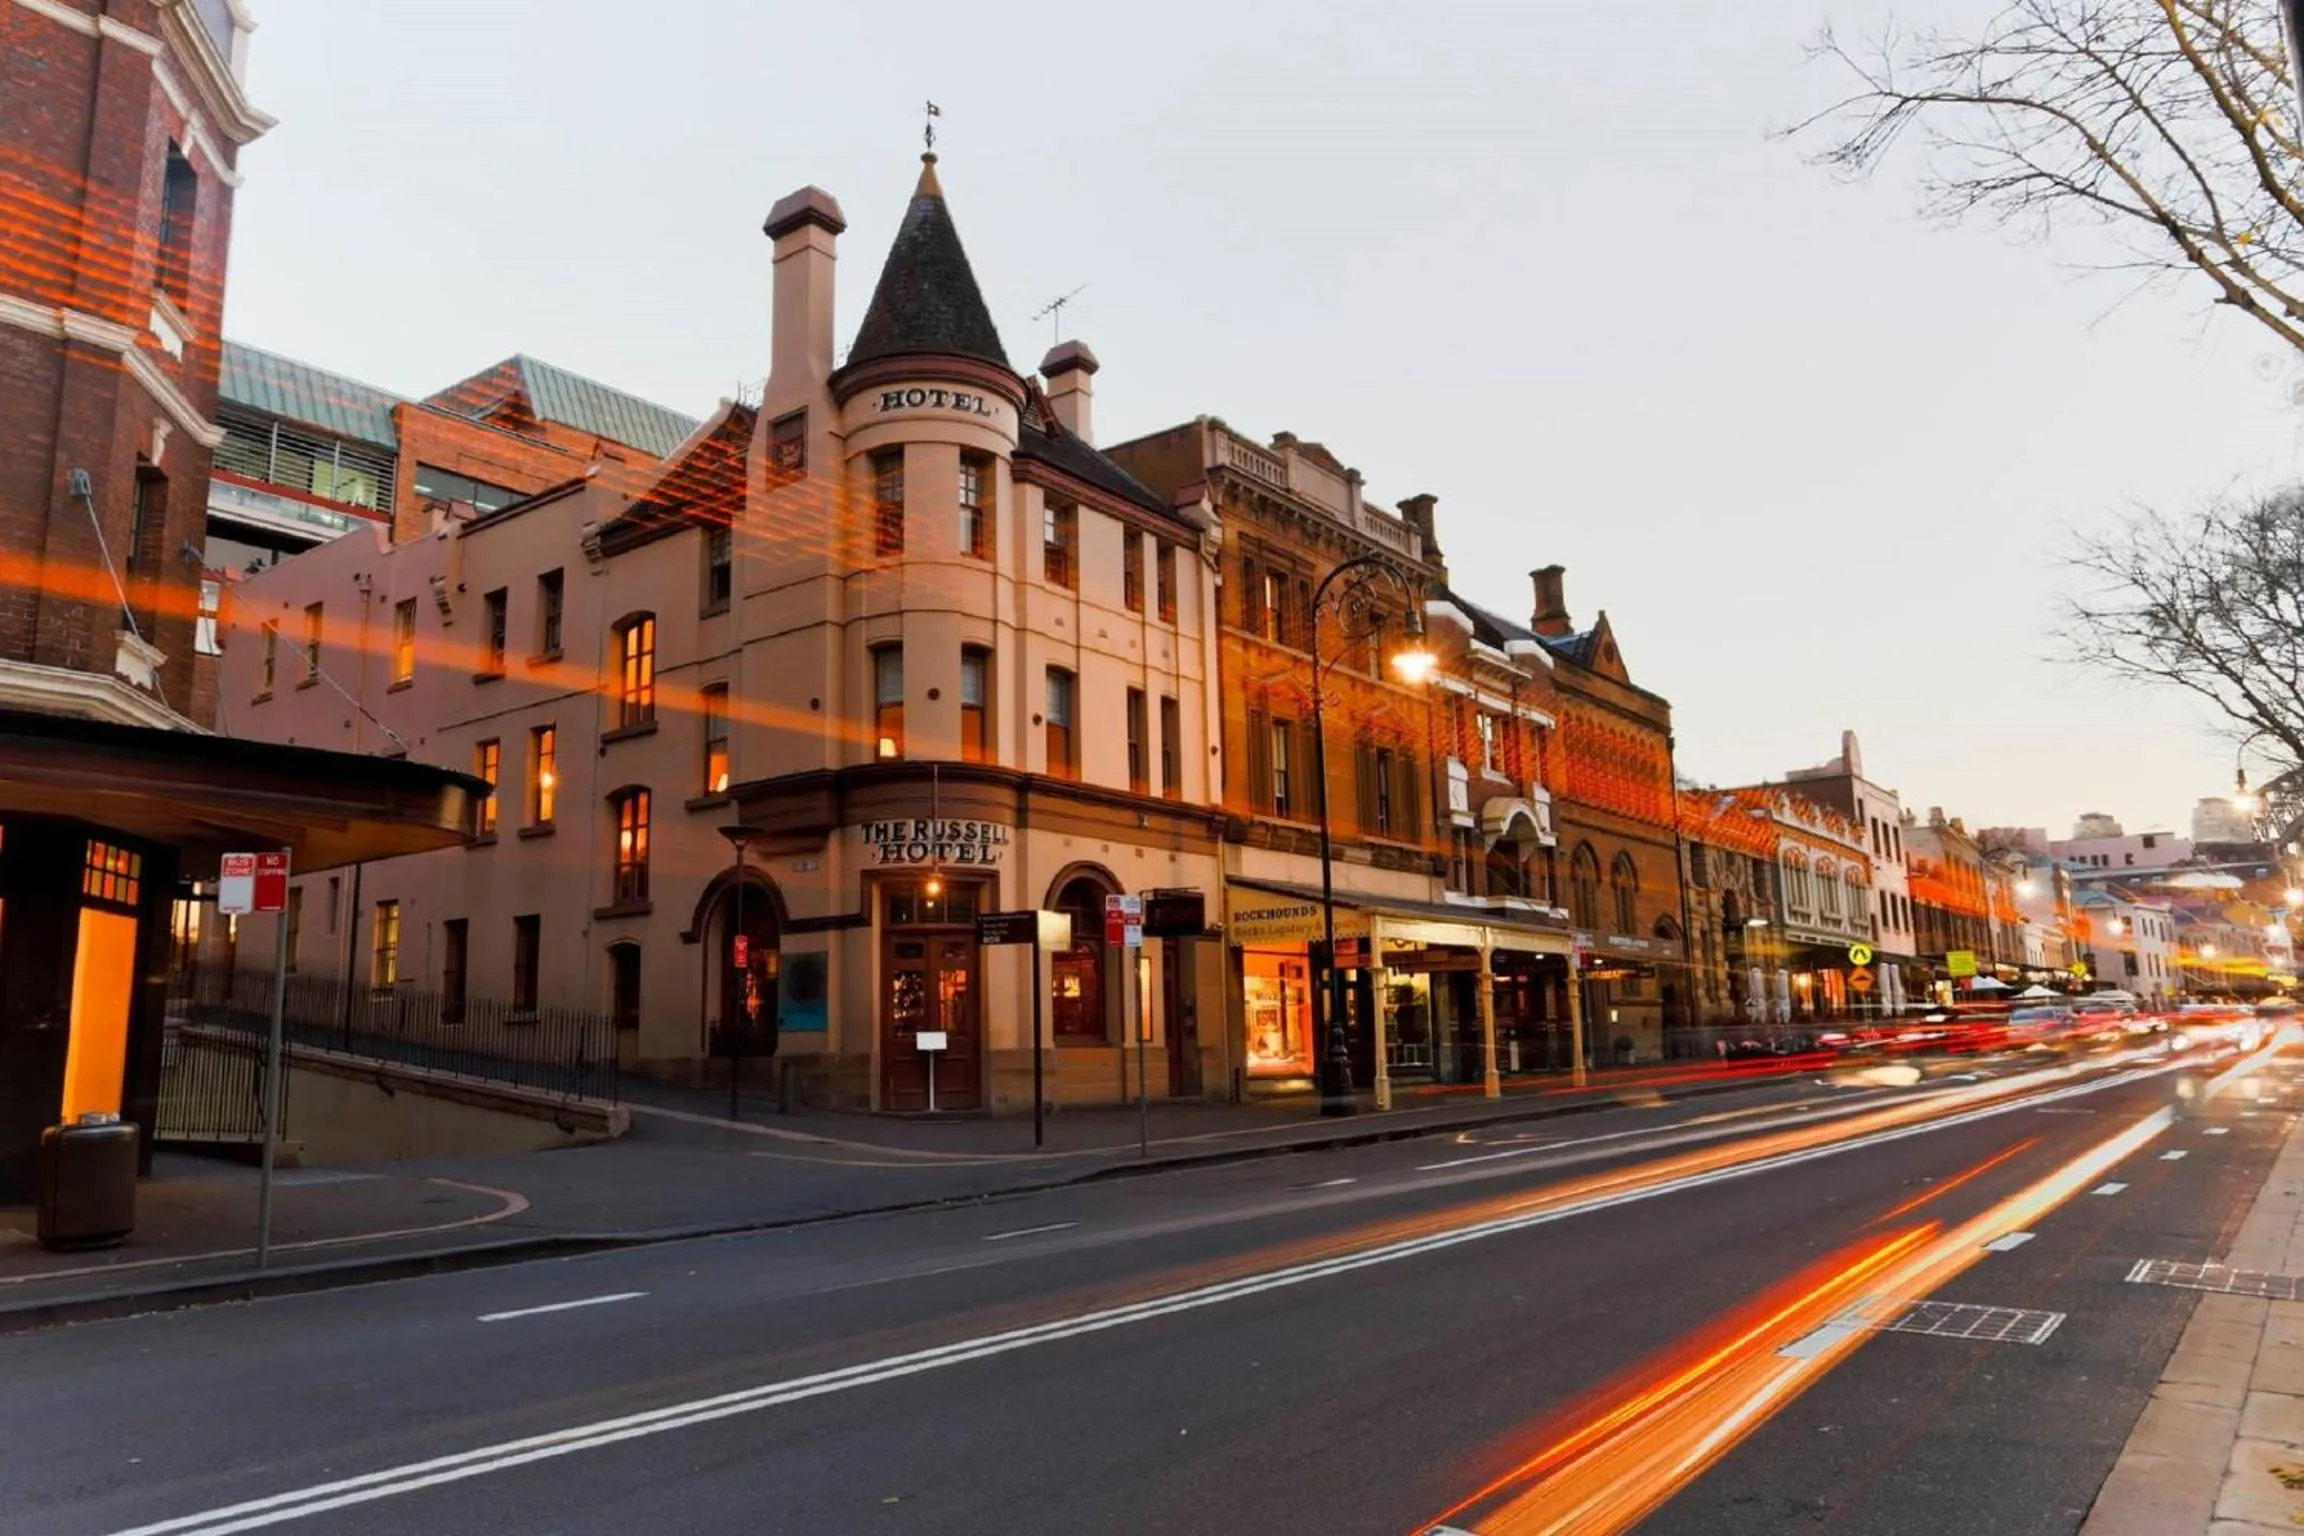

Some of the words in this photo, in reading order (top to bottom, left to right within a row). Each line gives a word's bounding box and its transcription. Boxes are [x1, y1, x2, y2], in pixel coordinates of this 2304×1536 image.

[880, 388, 991, 417] HOTEL
[862, 820, 907, 845] THE
[911, 820, 1010, 846] RUSSELL
[879, 842, 996, 865] HOTEL
[1234, 905, 1317, 922] ROCKHOUNDS
